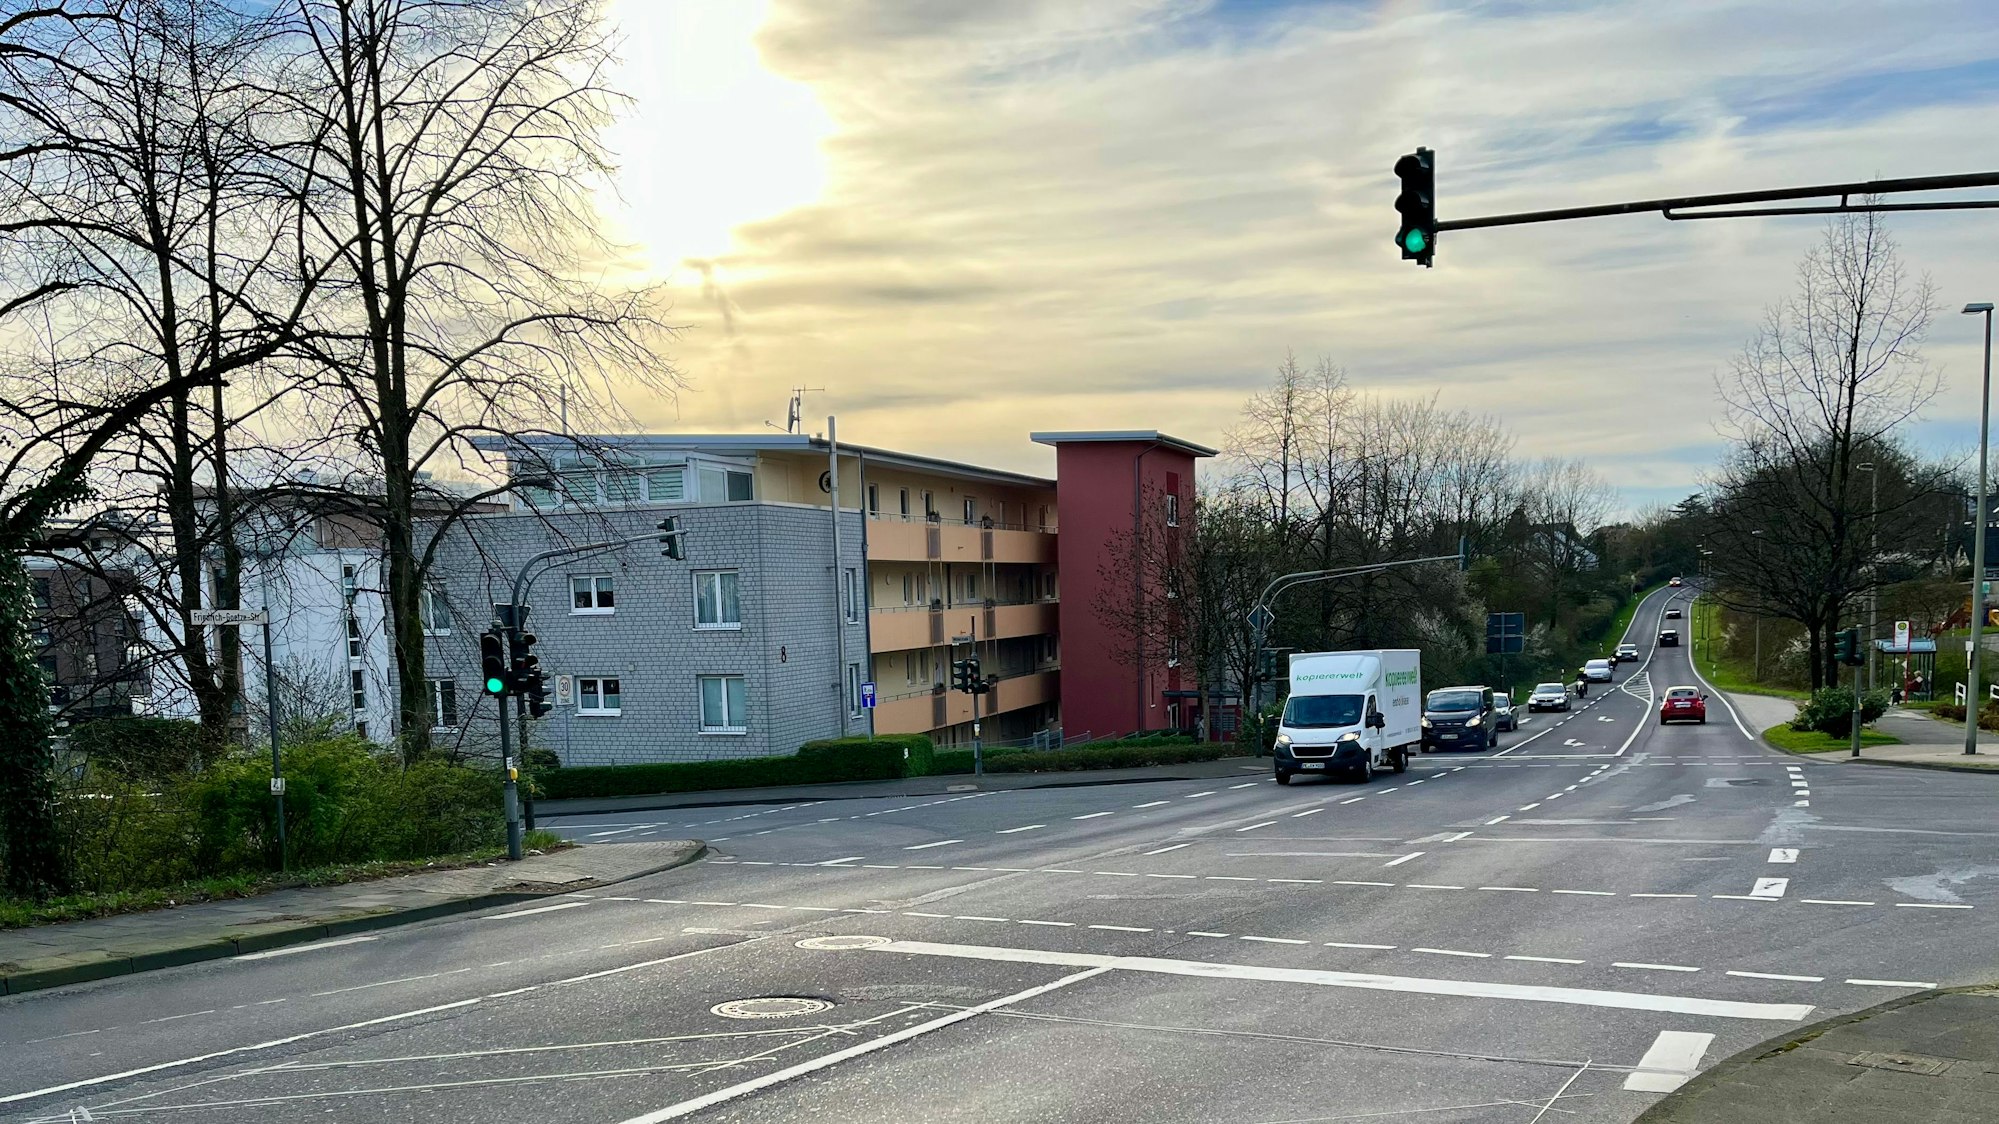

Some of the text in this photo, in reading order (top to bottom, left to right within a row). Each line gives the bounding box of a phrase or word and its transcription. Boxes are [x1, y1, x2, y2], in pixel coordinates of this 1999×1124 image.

[781, 645, 786, 663] 8
[1296, 672, 1364, 682] kopiererwelt
[560, 681, 569, 691] 30
